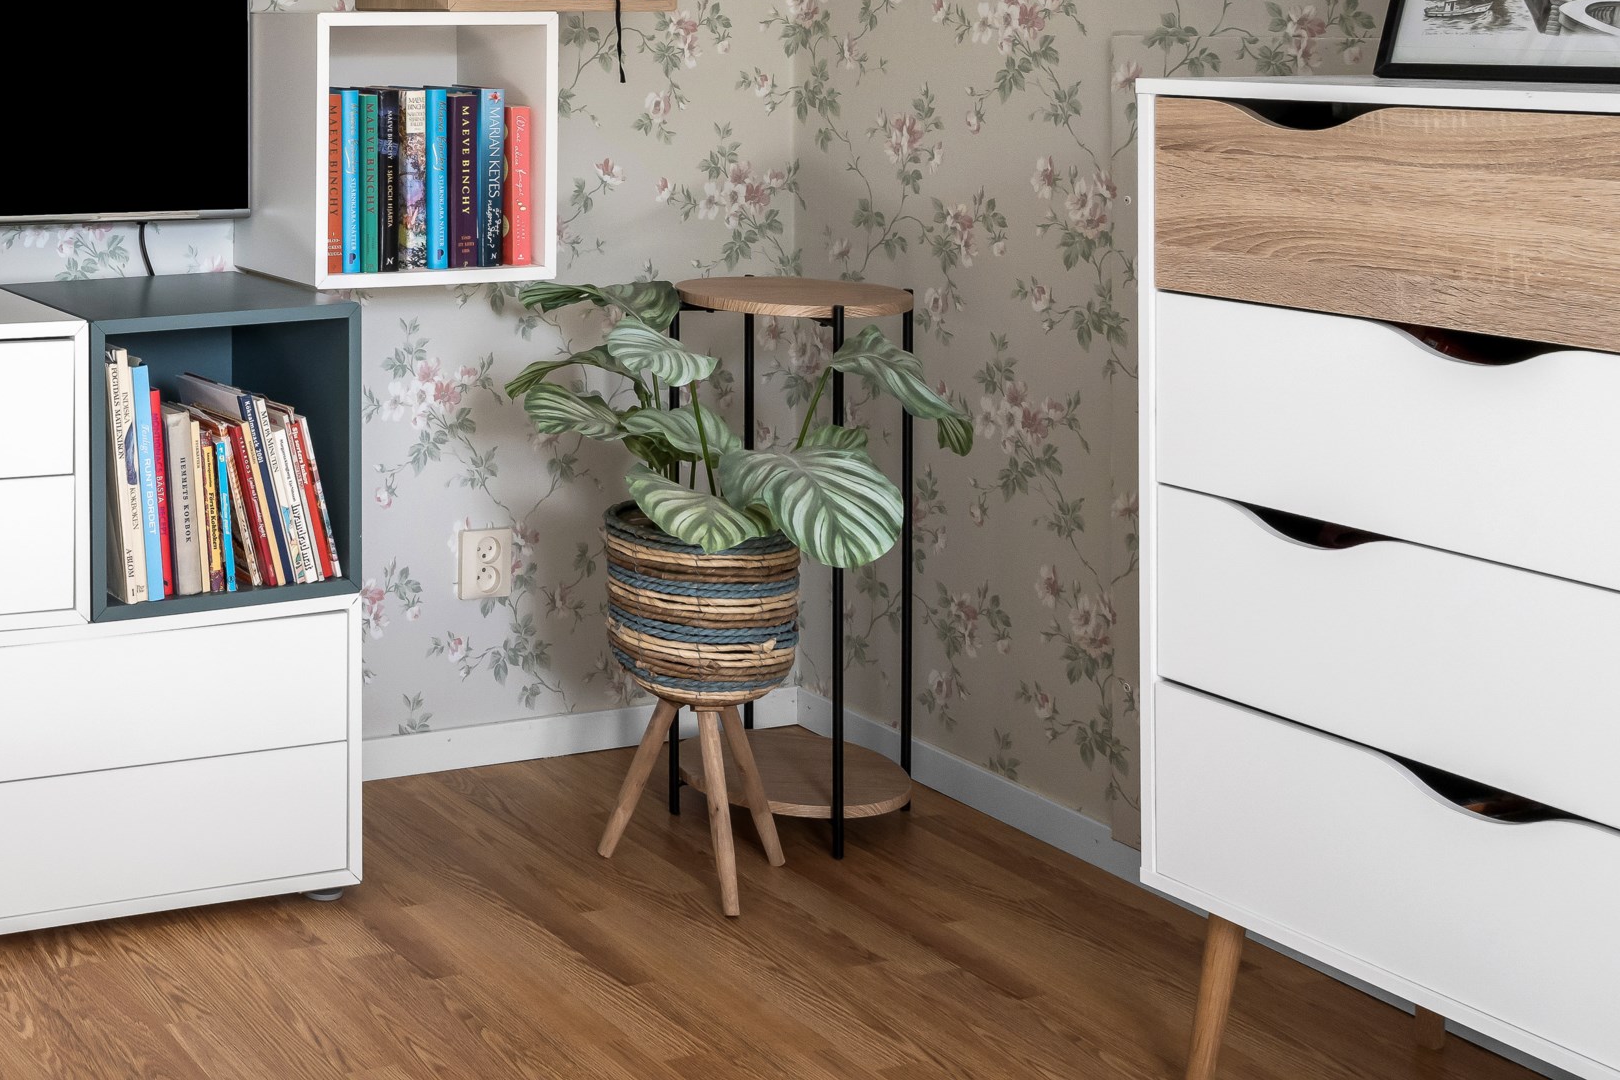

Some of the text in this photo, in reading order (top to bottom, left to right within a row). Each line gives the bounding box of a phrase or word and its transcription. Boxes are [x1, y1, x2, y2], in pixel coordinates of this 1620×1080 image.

[329, 105, 340, 216] MAEVE BINCHY
[366, 103, 375, 214] MAEVE BINCHY
[462, 105, 470, 215] MAEVE BINCHY
[488, 107, 500, 198] MARIAN KEYES
[515, 115, 526, 143] What
[111, 367, 125, 459] FOGTDALS MATLEXIKON
[244, 400, 259, 449] Köksalmanack
[255, 449, 264, 464] 2001
[261, 410, 279, 473] MAT PÅ MINUTEN
[291, 426, 299, 438] Sju
[122, 391, 139, 530] INDISKA KOKBOKEN
[294, 439, 305, 464] sorters
[300, 464, 309, 486] kakor
[143, 458, 157, 536] RUNT BORDET
[155, 475, 168, 536] BÄSTA RECEPT
[179, 457, 192, 543] HEMMETS KOKBOK
[302, 551, 313, 571] mat
